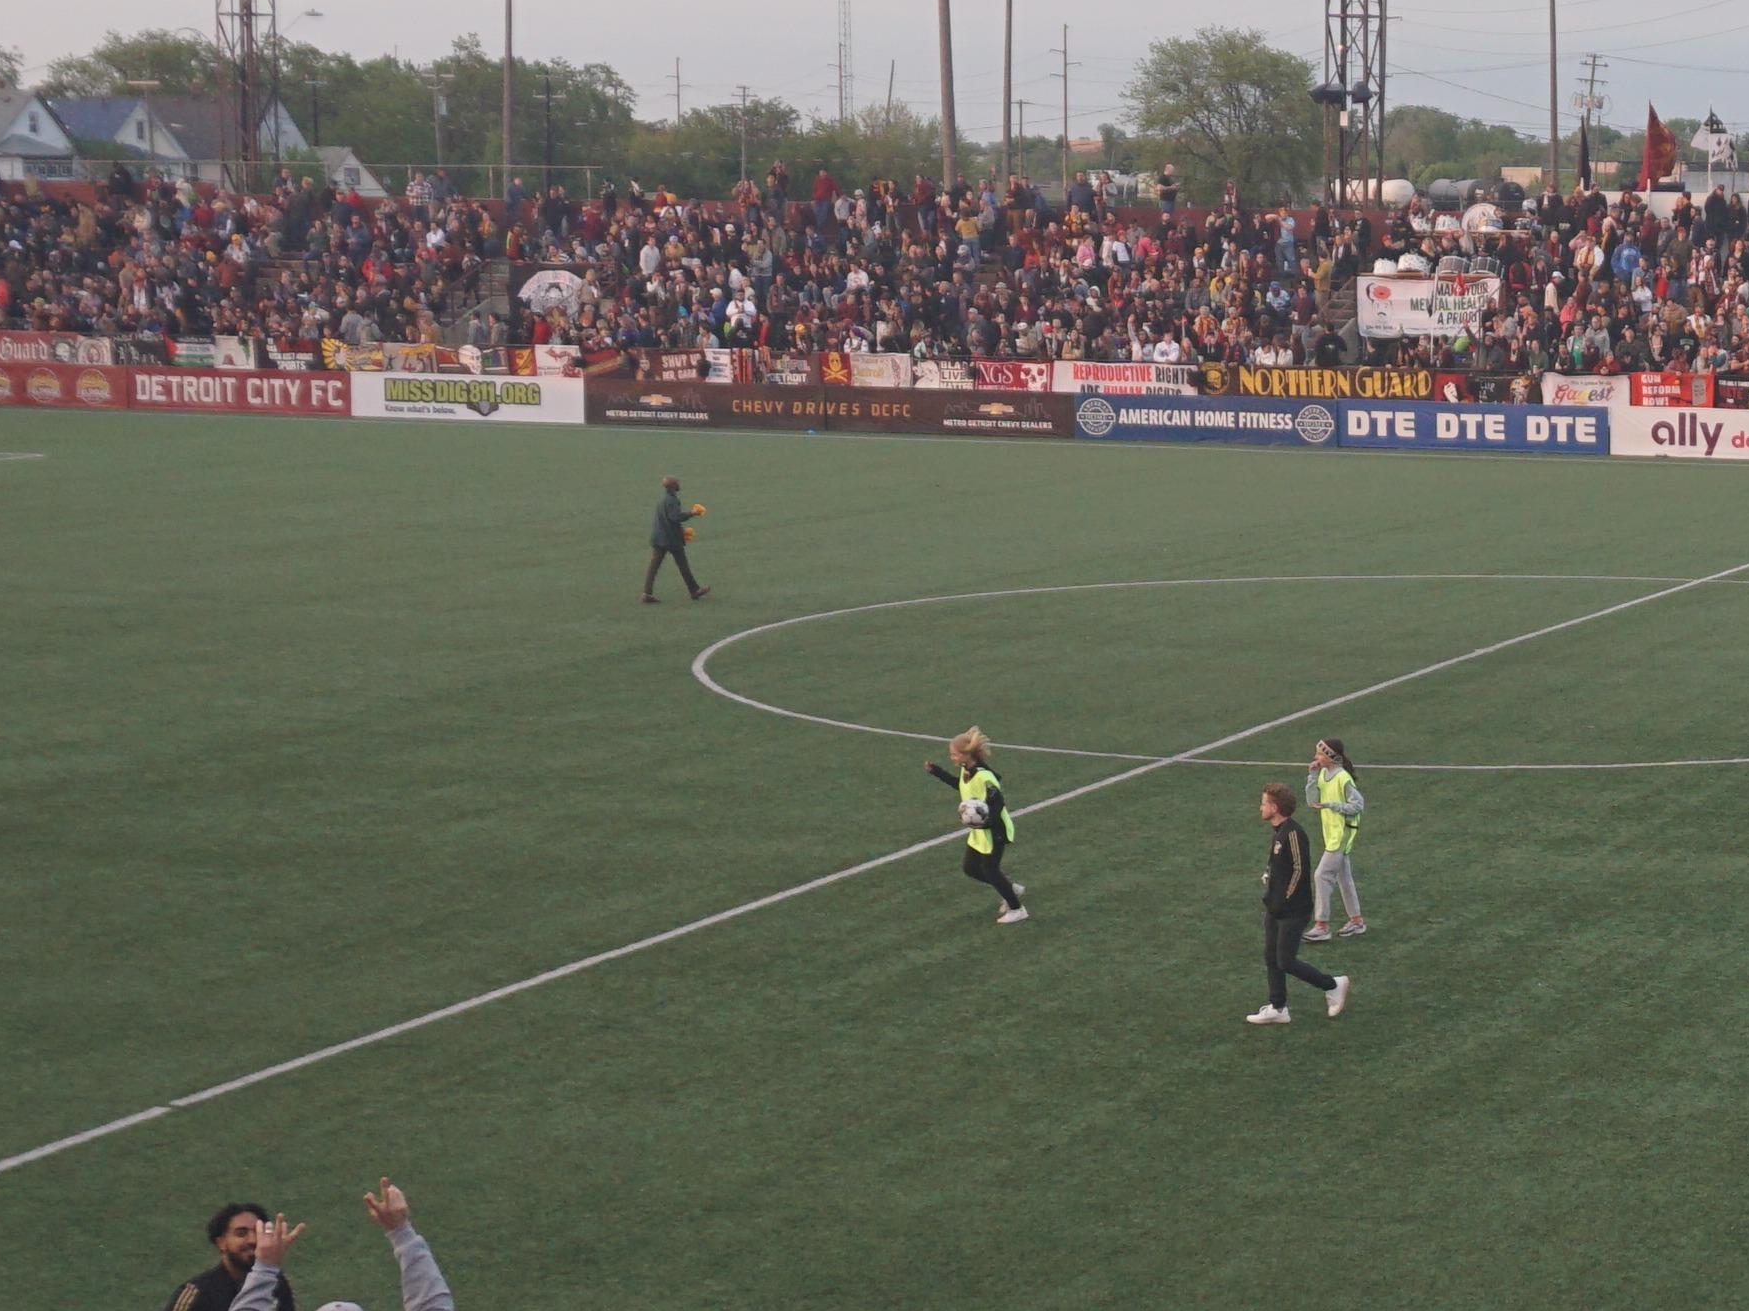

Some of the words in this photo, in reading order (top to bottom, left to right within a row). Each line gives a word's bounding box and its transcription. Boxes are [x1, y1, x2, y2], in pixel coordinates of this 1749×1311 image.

[979, 363, 1015, 384] NGS
[1073, 363, 1153, 383] REPRODUCTIVE
[1238, 364, 1351, 399] NORTHERN
[1354, 366, 1432, 399] GUARD
[134, 373, 237, 404] DETROIT
[245, 377, 301, 405] CITY
[310, 379, 344, 407] FC
[1642, 385, 1682, 395] REFORM
[732, 399, 784, 415] CHEVY
[792, 400, 861, 417] DRIVES
[871, 403, 912, 418] DCFC
[1118, 408, 1192, 426] AMERICAN
[1194, 410, 1236, 428] HOME
[1238, 411, 1293, 430] FITNESS
[1347, 409, 1416, 438] DTE
[1436, 412, 1505, 440] DTE
[1526, 415, 1596, 443] DTE
[1651, 412, 1724, 456] ally
